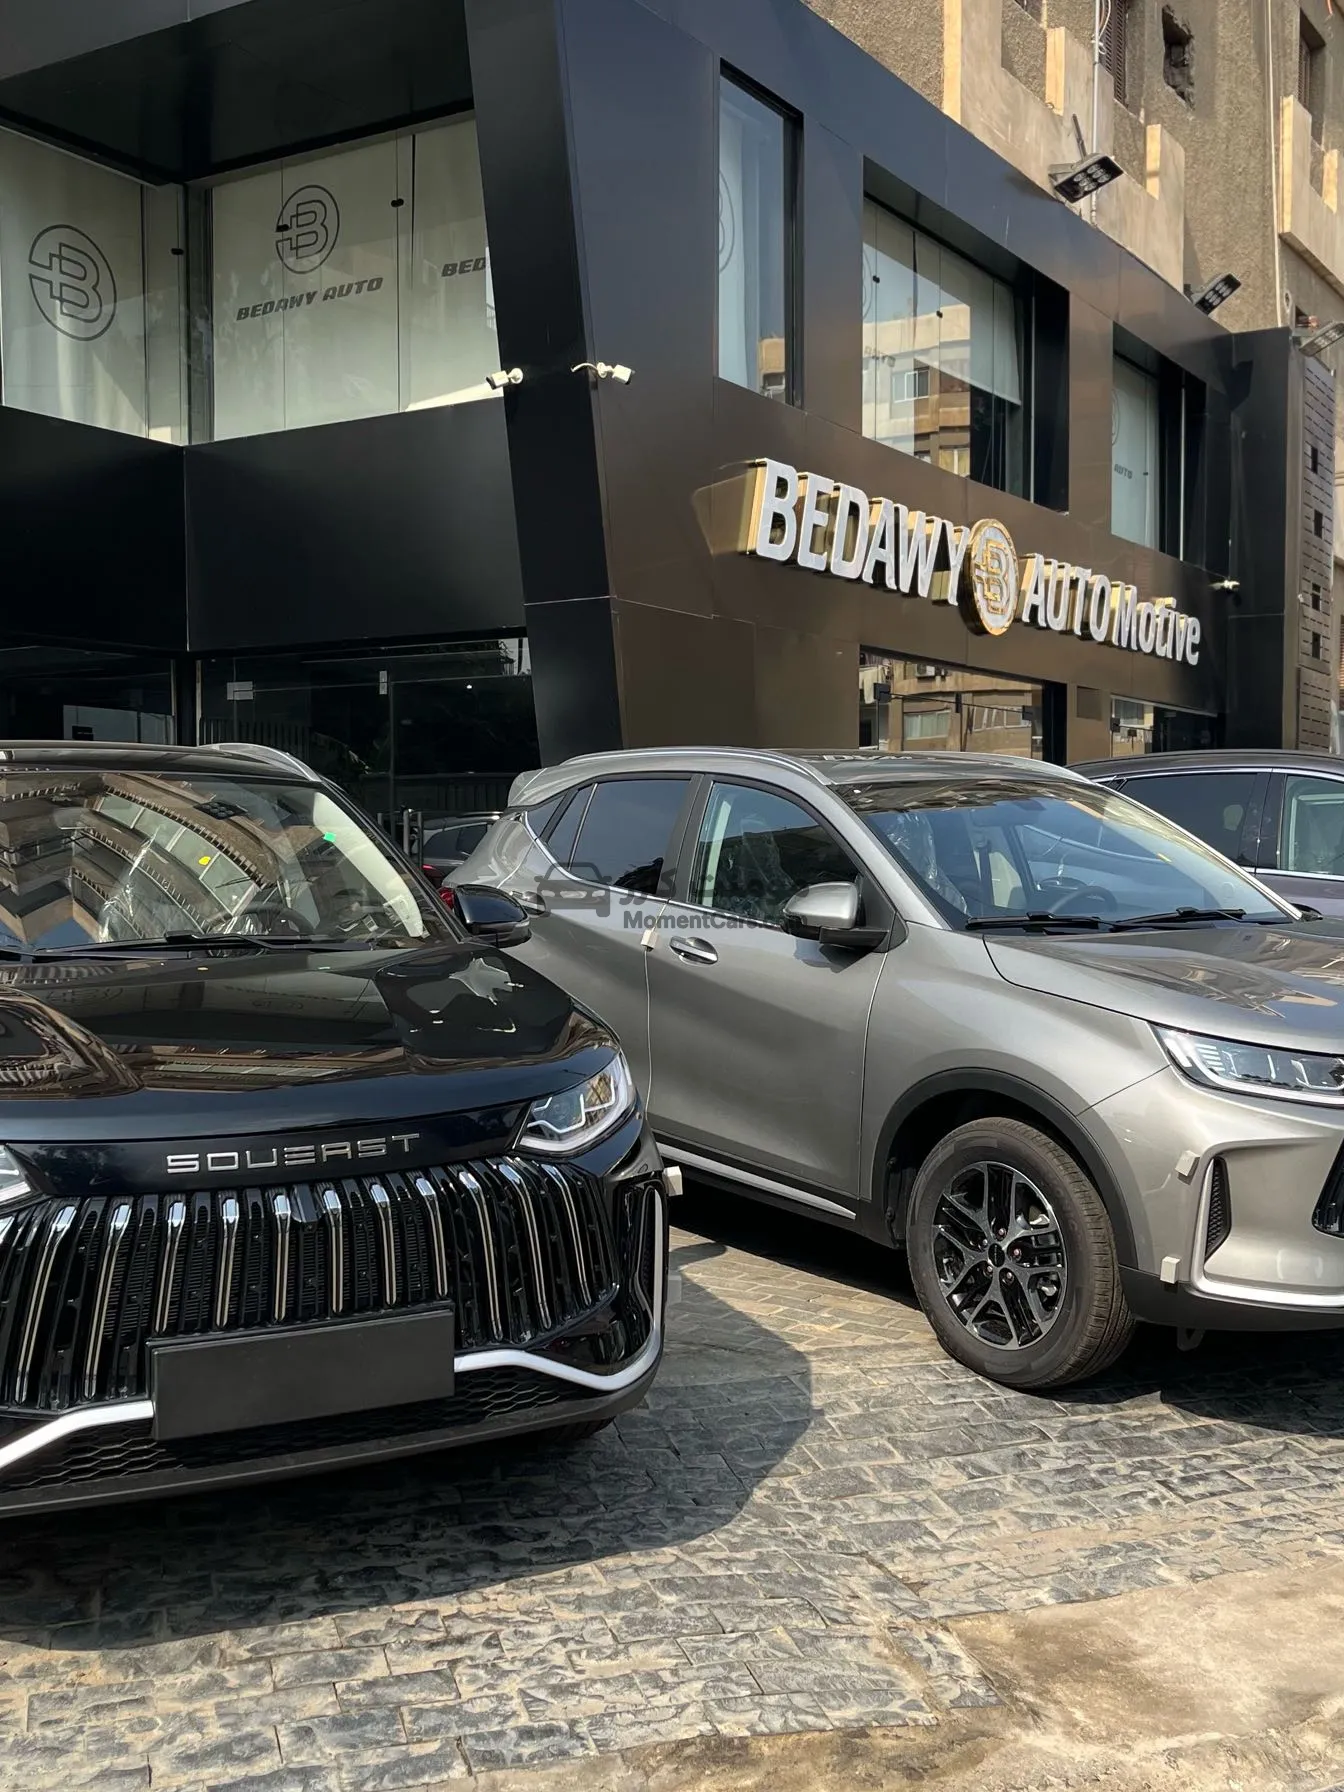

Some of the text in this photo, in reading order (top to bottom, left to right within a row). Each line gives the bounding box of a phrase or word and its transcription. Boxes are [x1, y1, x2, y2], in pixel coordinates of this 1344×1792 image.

[236, 277, 384, 321] BEDAWY AUTO
[753, 458, 971, 606] BEDAWY
[166, 1132, 421, 1174] SOUEAST
